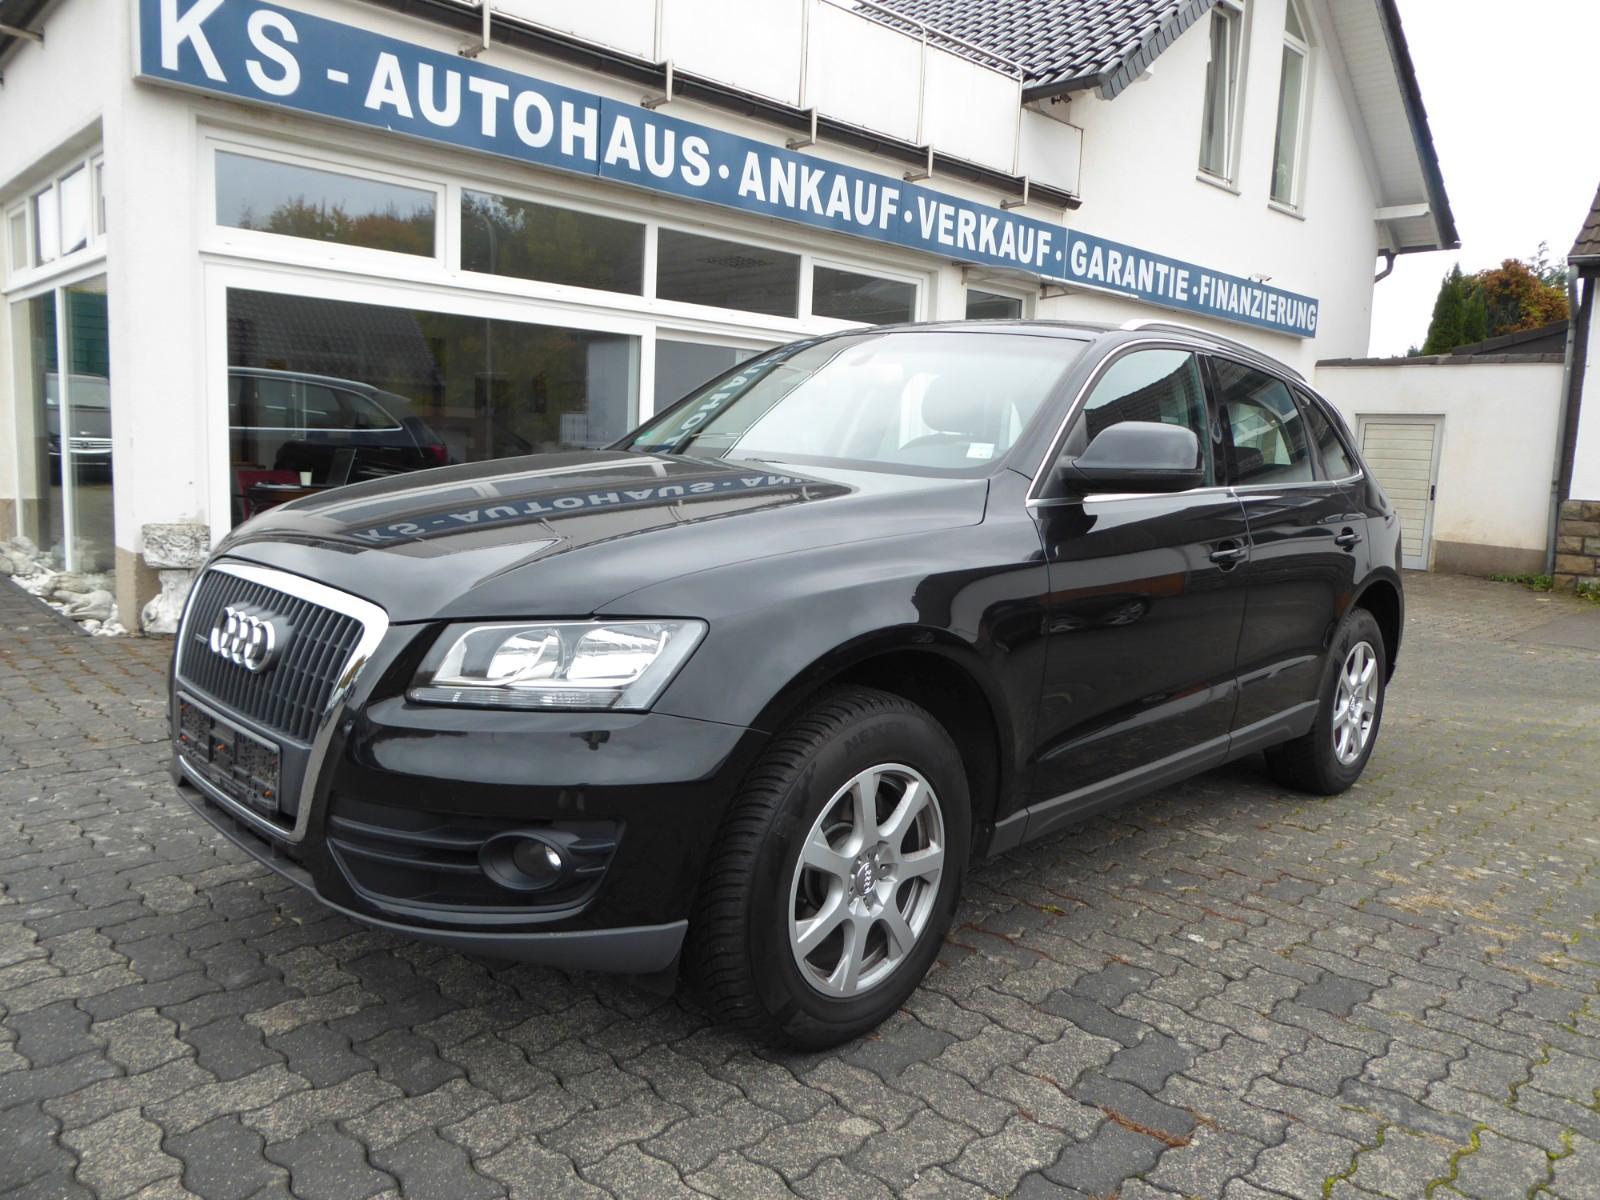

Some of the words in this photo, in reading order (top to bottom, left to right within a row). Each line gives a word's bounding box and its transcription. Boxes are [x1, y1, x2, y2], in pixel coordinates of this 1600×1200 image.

[161, 0, 301, 96] KS
[365, 52, 711, 187] AUTOHAUS
[738, 151, 900, 230] ANKAUF
[917, 197, 1052, 267] VERKAUF
[1070, 241, 1190, 301] GARANTIE
[1199, 275, 1317, 331] FINANZIERUNG
